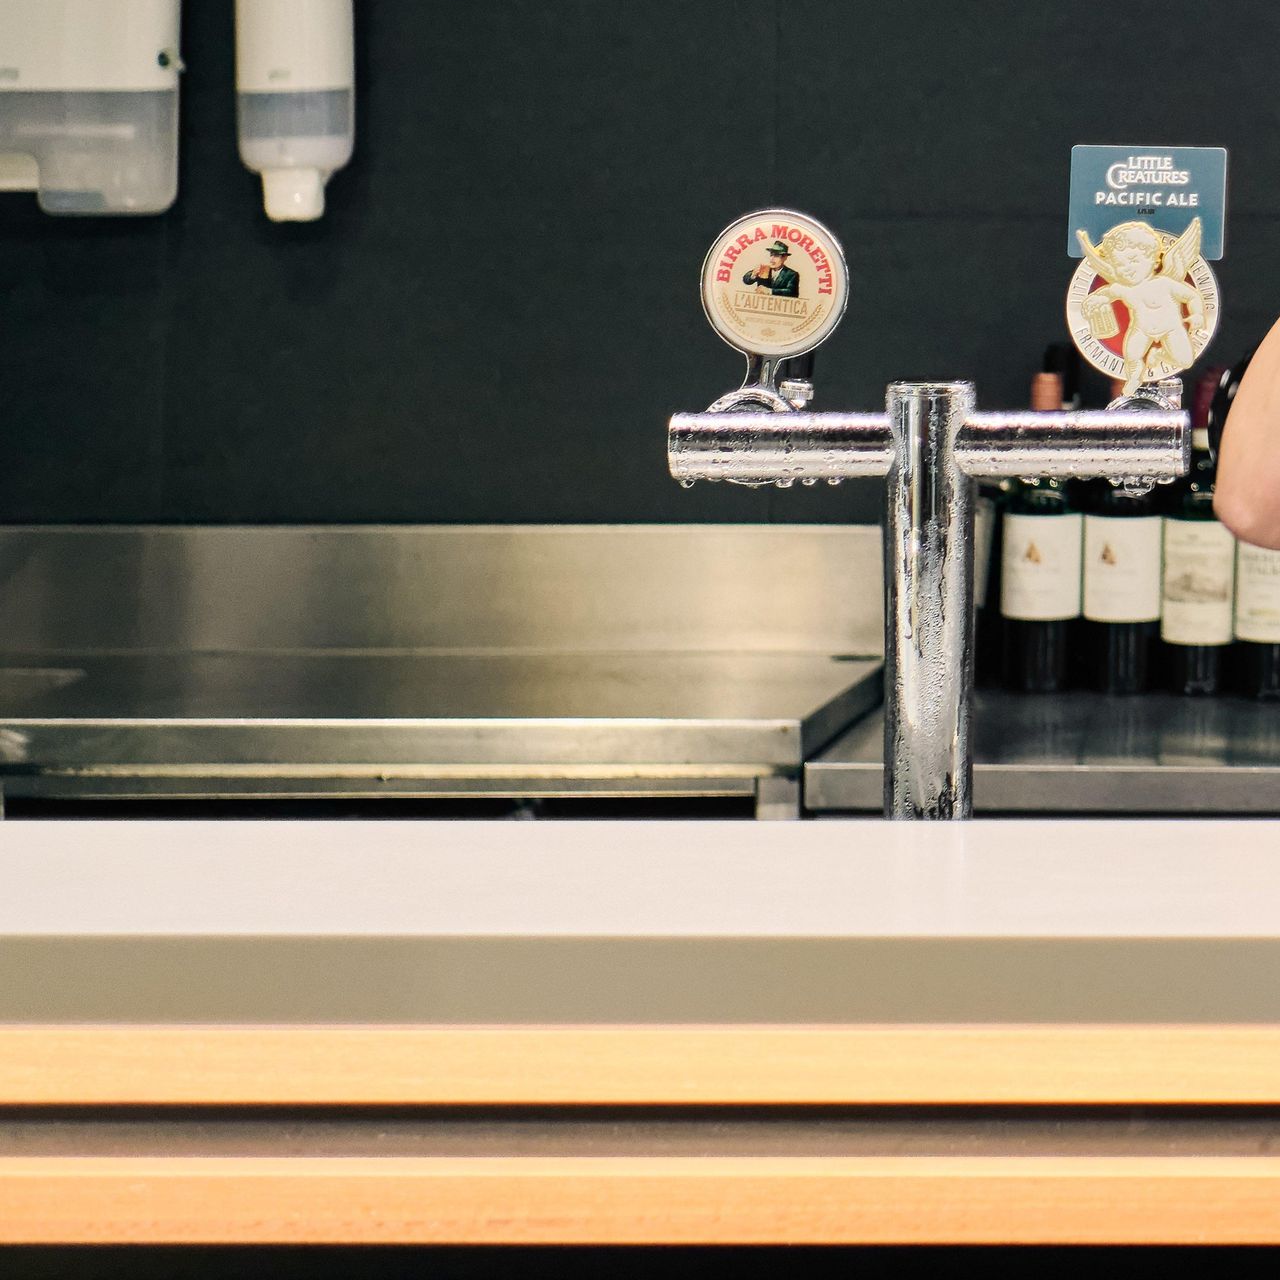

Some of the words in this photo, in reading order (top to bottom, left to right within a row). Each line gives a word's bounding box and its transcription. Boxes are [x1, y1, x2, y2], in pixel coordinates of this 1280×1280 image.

[1128, 156, 1174, 170] LITTLE
[1106, 163, 1190, 189] CREATURES
[1095, 191, 1163, 206] PACIFIC
[1166, 193, 1199, 207] ALE
[716, 227, 768, 284] BIRRA
[771, 224, 833, 295] MORETTI
[734, 294, 809, 316] L'AUTENTICA
[1075, 328, 1126, 375] FREMANT
